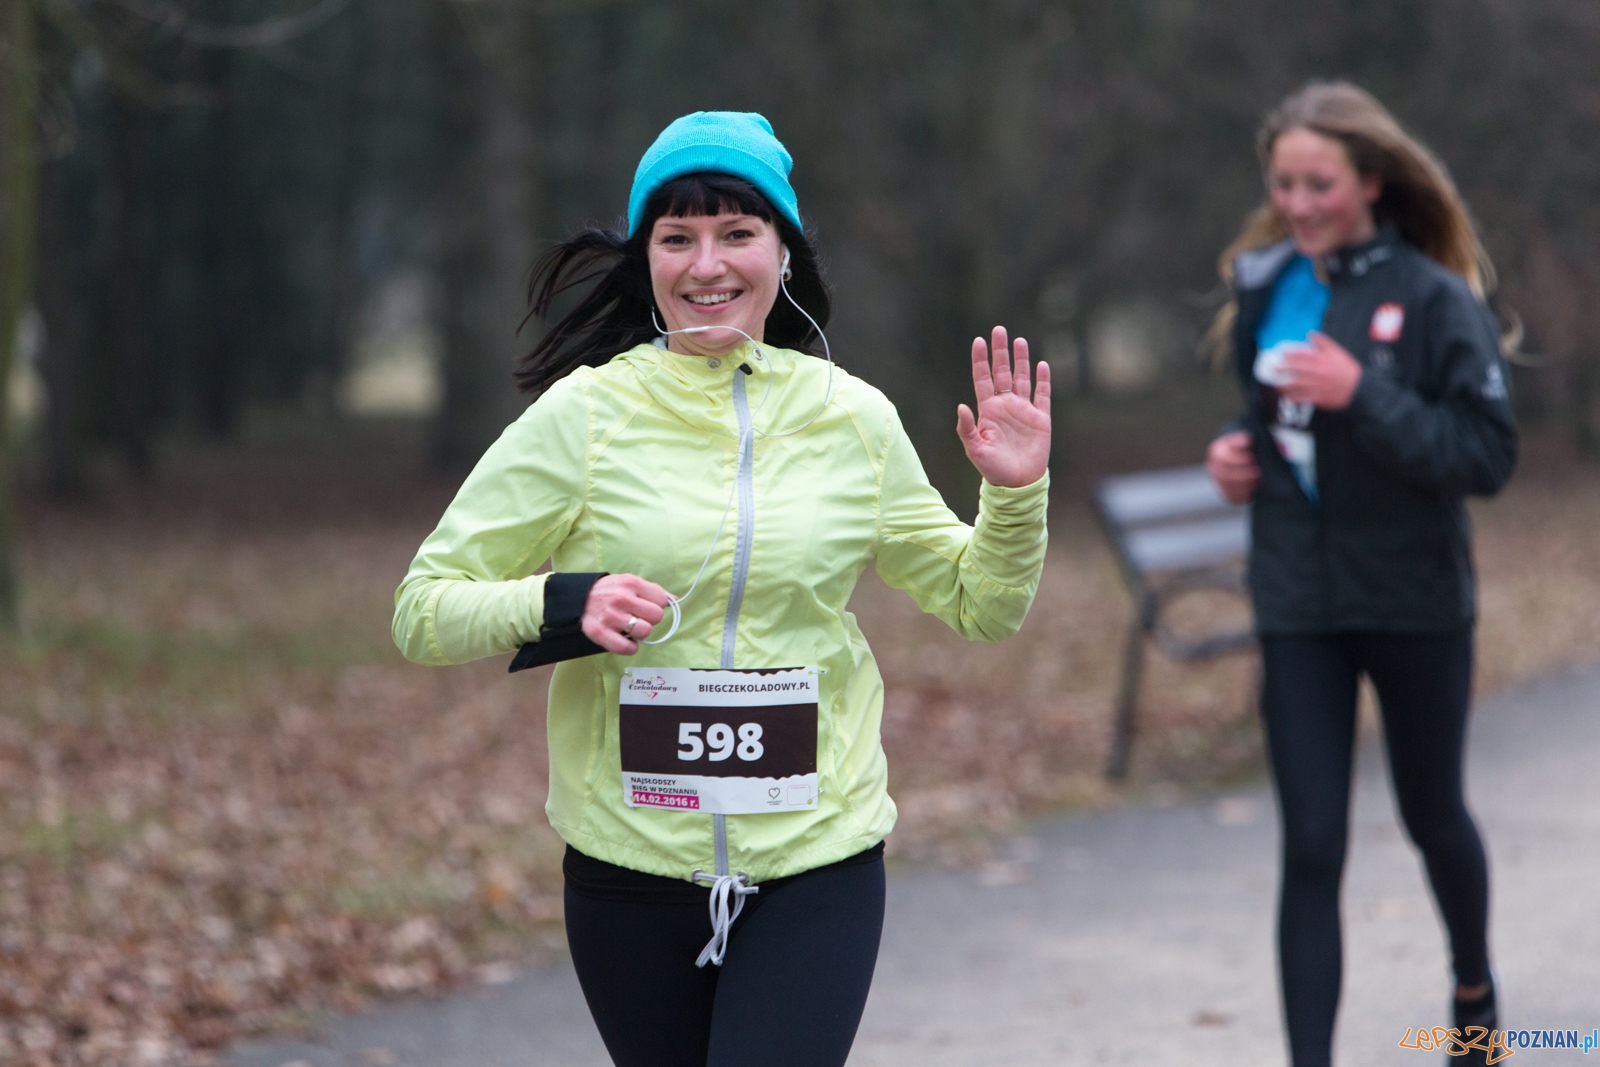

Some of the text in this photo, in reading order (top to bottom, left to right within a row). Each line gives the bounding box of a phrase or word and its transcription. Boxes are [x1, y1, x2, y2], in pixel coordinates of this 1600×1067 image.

[628, 684, 678, 692] Czekoladowy
[698, 682, 810, 693] BIEGCZEKOLADOWY.PL
[677, 722, 764, 762] 598
[630, 777, 676, 786] NAJSŁODSZY
[658, 787, 698, 795] POZNANIU
[634, 793, 688, 806] 14.02.2016
